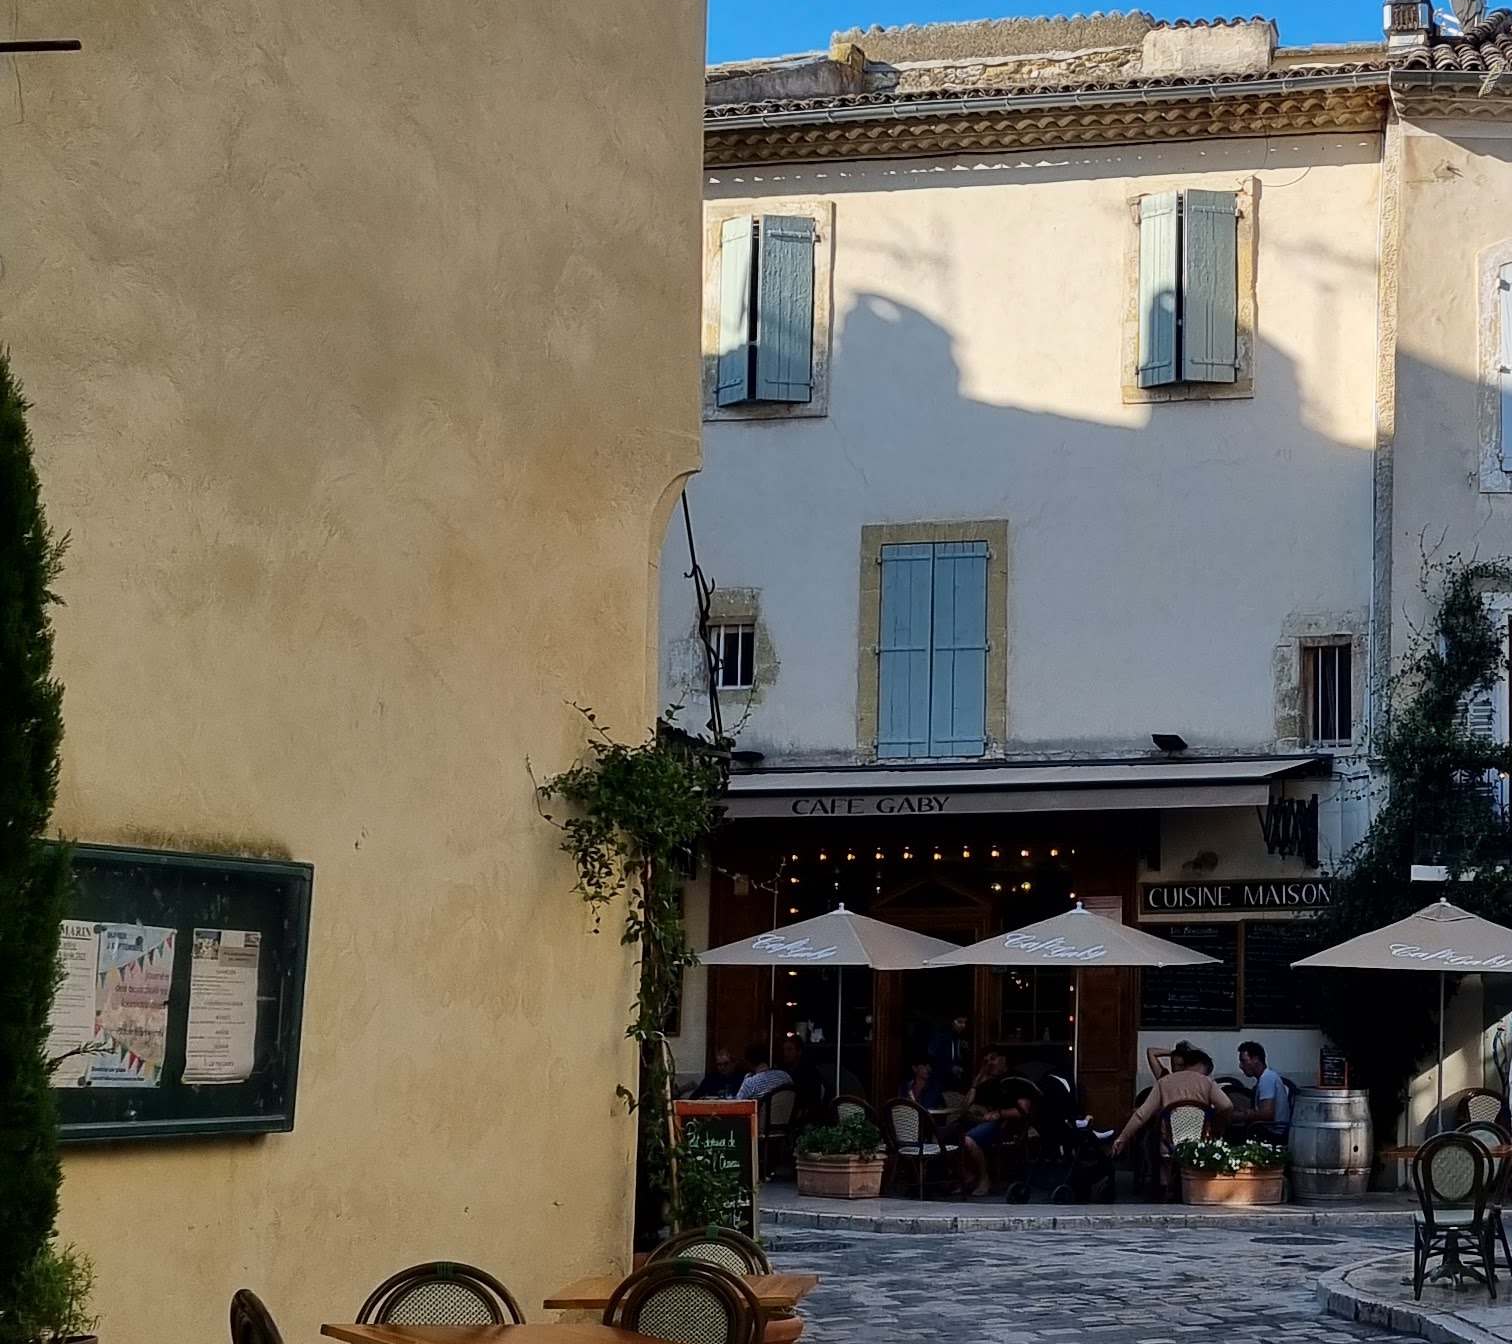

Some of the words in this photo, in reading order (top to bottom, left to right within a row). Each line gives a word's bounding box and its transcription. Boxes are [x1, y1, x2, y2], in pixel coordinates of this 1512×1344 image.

[792, 798, 865, 815] CAFE
[876, 796, 950, 814] GABY
[1148, 885, 1232, 908] CUISINE
[1243, 882, 1332, 905] MAISON
